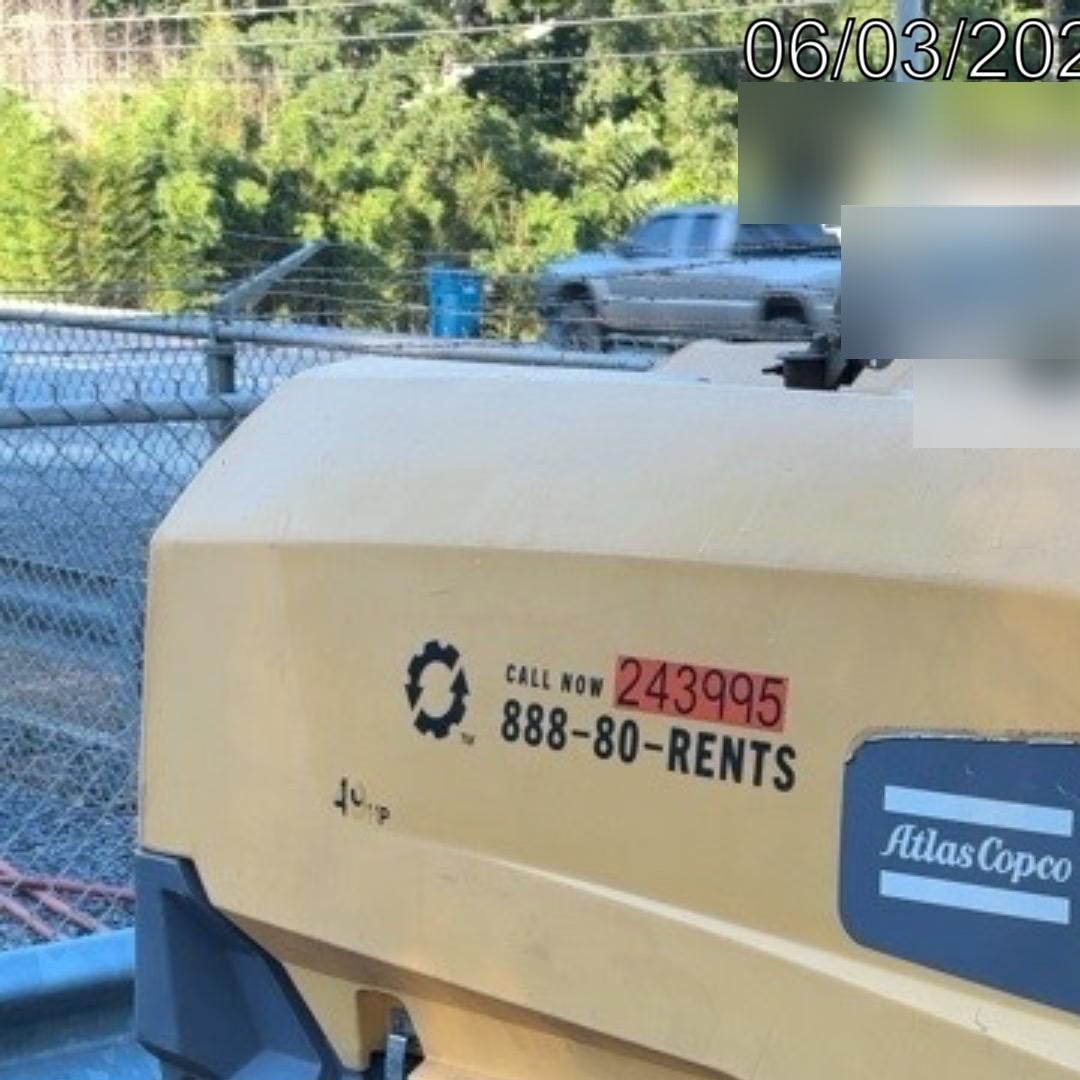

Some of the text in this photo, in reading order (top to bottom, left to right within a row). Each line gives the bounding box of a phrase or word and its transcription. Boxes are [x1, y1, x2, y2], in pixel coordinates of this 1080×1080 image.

[506, 664, 603, 697] CALL NOW
[617, 657, 784, 727] 243995
[501, 699, 796, 792] 888-80-RENTS
[881, 824, 1072, 883] Atlas Copco
